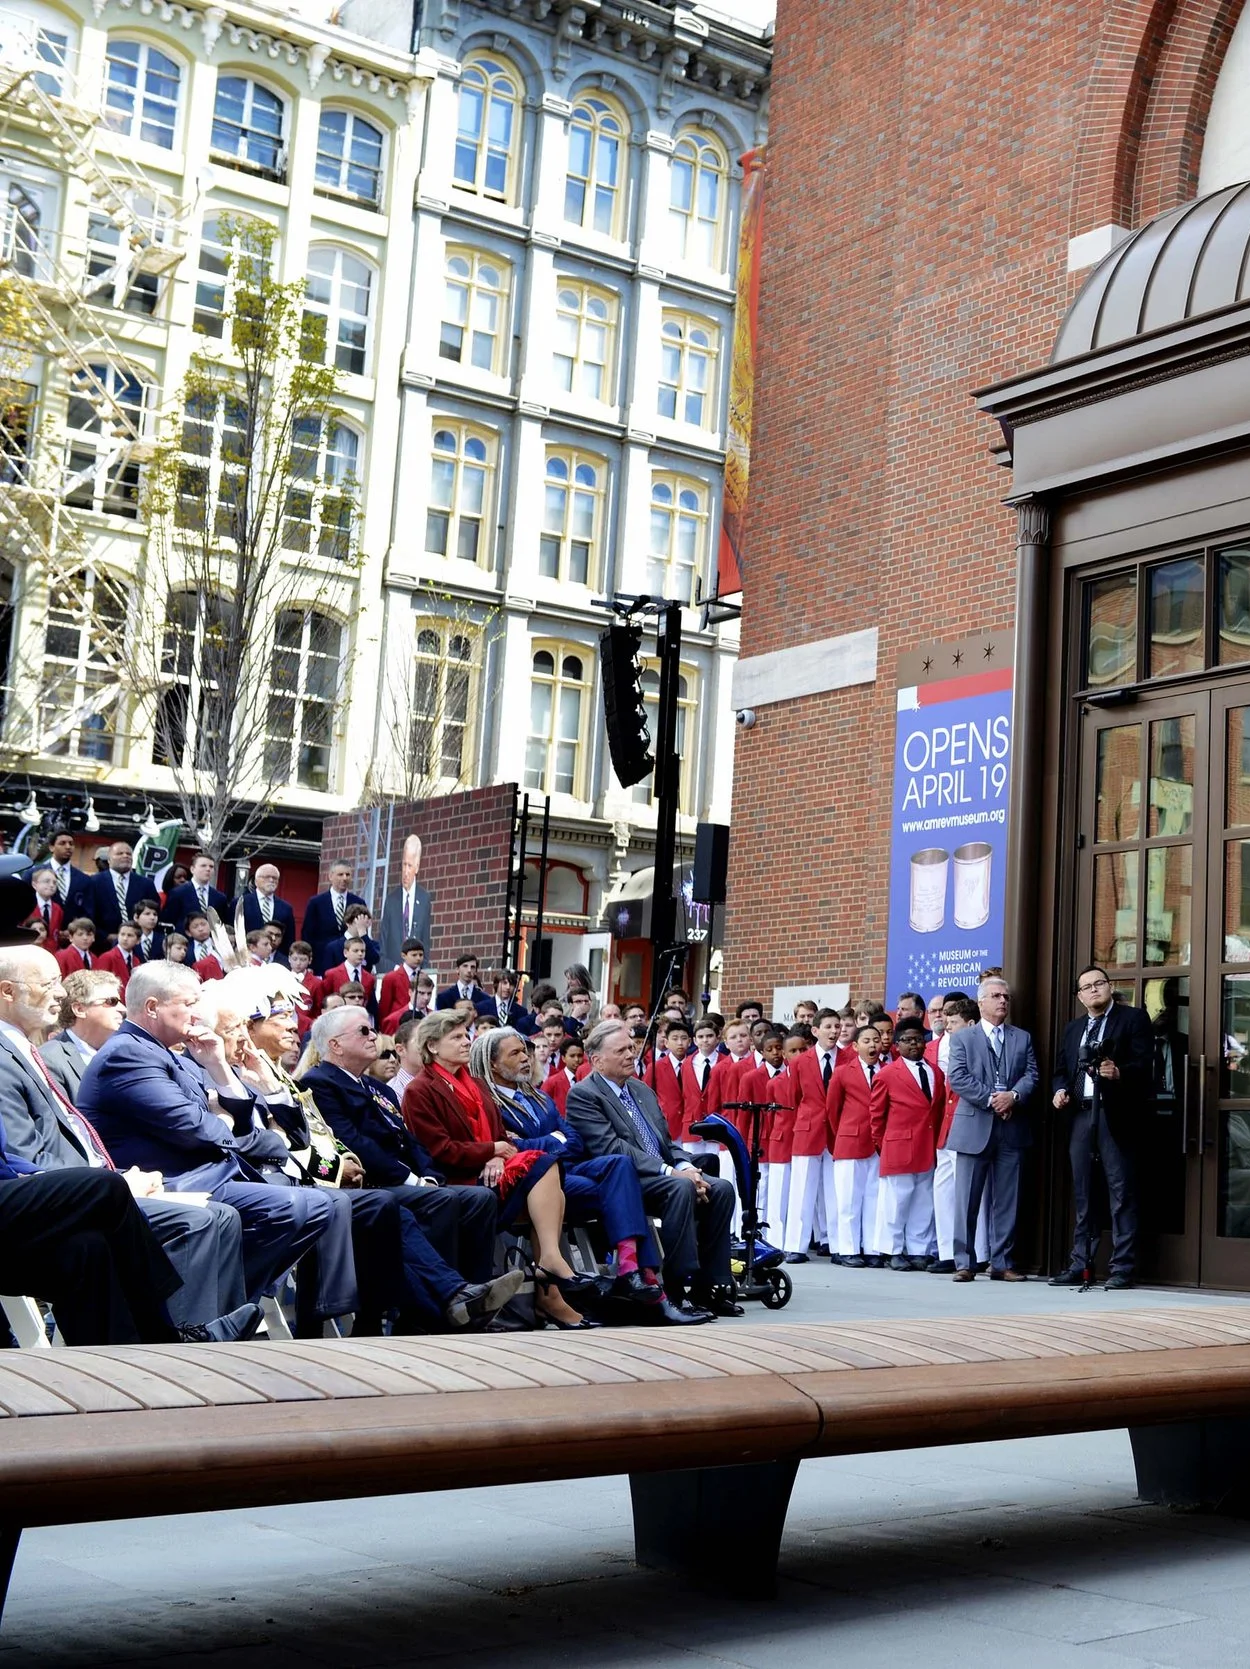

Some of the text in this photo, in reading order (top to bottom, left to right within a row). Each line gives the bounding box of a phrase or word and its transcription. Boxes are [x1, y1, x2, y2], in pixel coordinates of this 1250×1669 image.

[903, 715, 1009, 773] OPENS
[902, 763, 1007, 811] APRIL 19
[902, 808, 1006, 833] www.amrevmuseum.org
[687, 928, 708, 941] 237
[939, 949, 972, 961] MUSEUM
[980, 949, 988, 957] THE
[938, 962, 981, 974] AMERICAN
[938, 975, 980, 988] REVOLUTIO
